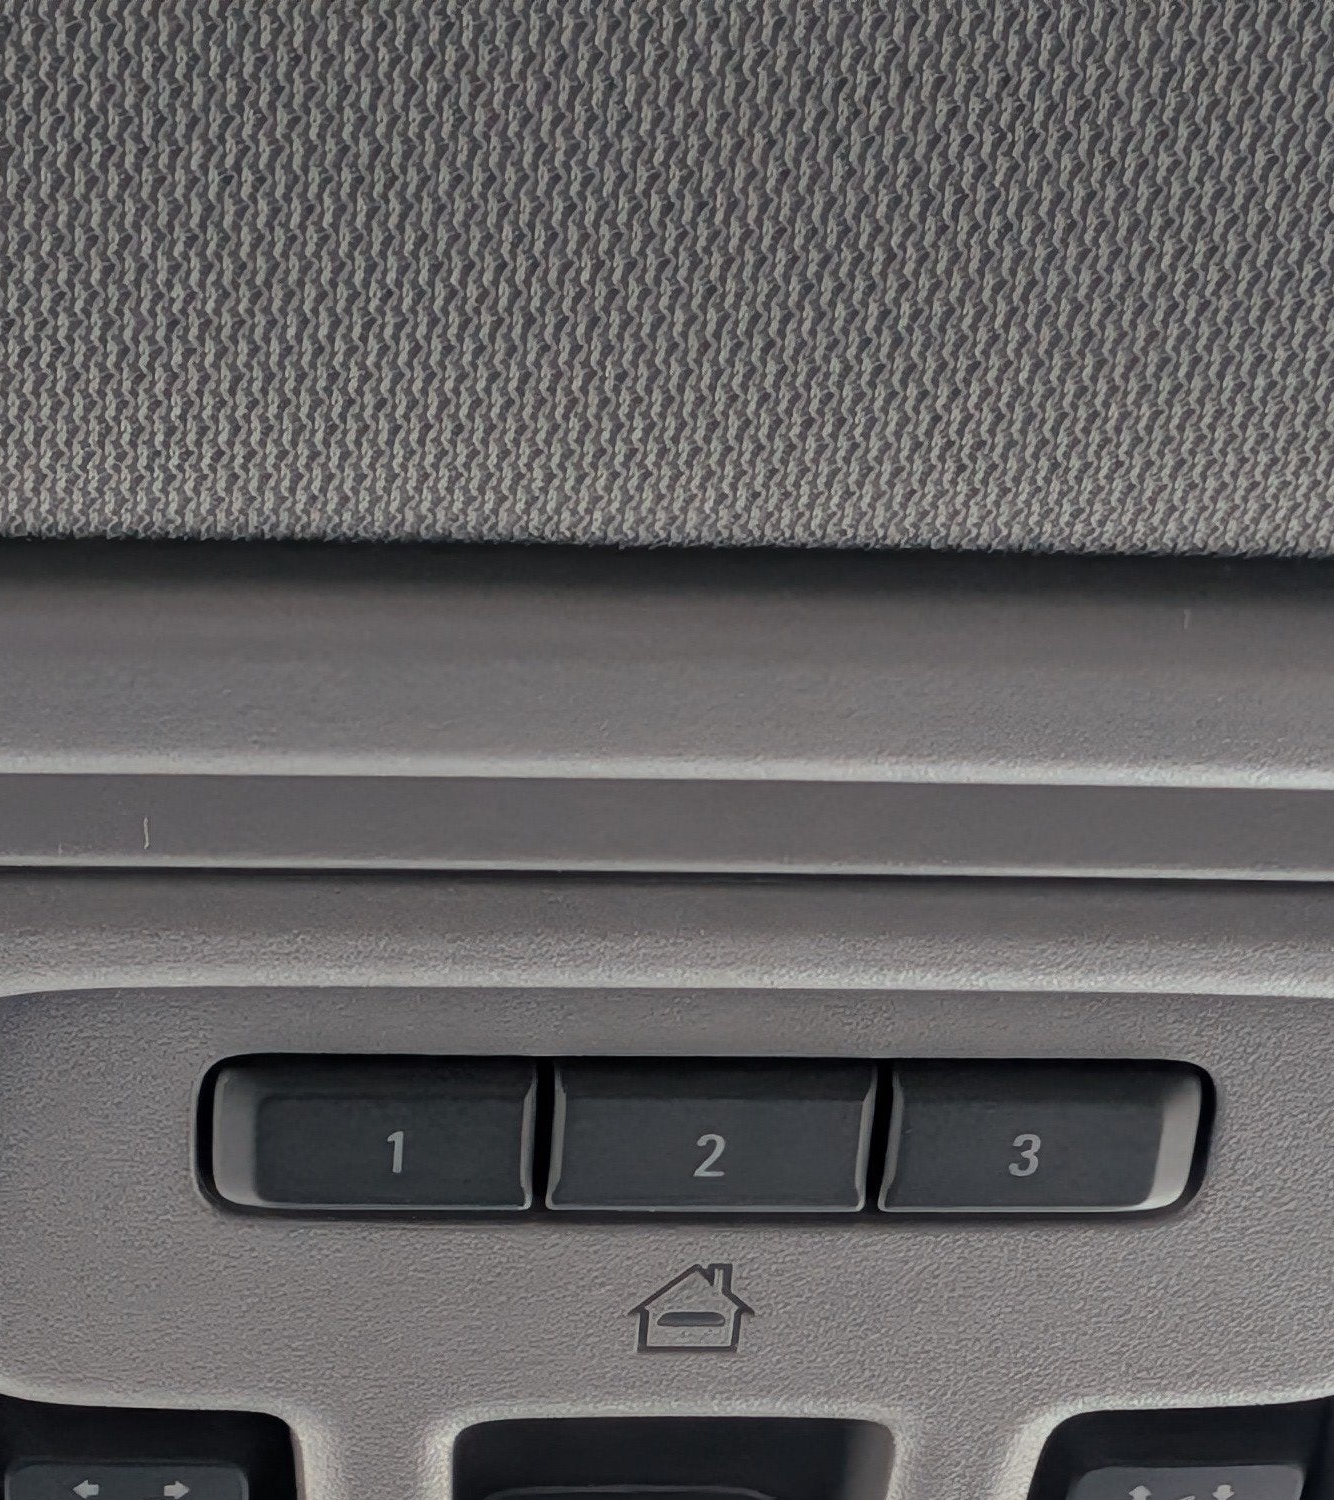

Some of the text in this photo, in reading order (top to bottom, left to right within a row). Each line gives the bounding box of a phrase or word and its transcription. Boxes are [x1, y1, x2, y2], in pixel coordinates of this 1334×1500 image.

[386, 1130, 404, 1174] 1
[693, 1133, 726, 1177] 2
[1008, 1133, 1042, 1177] 3
